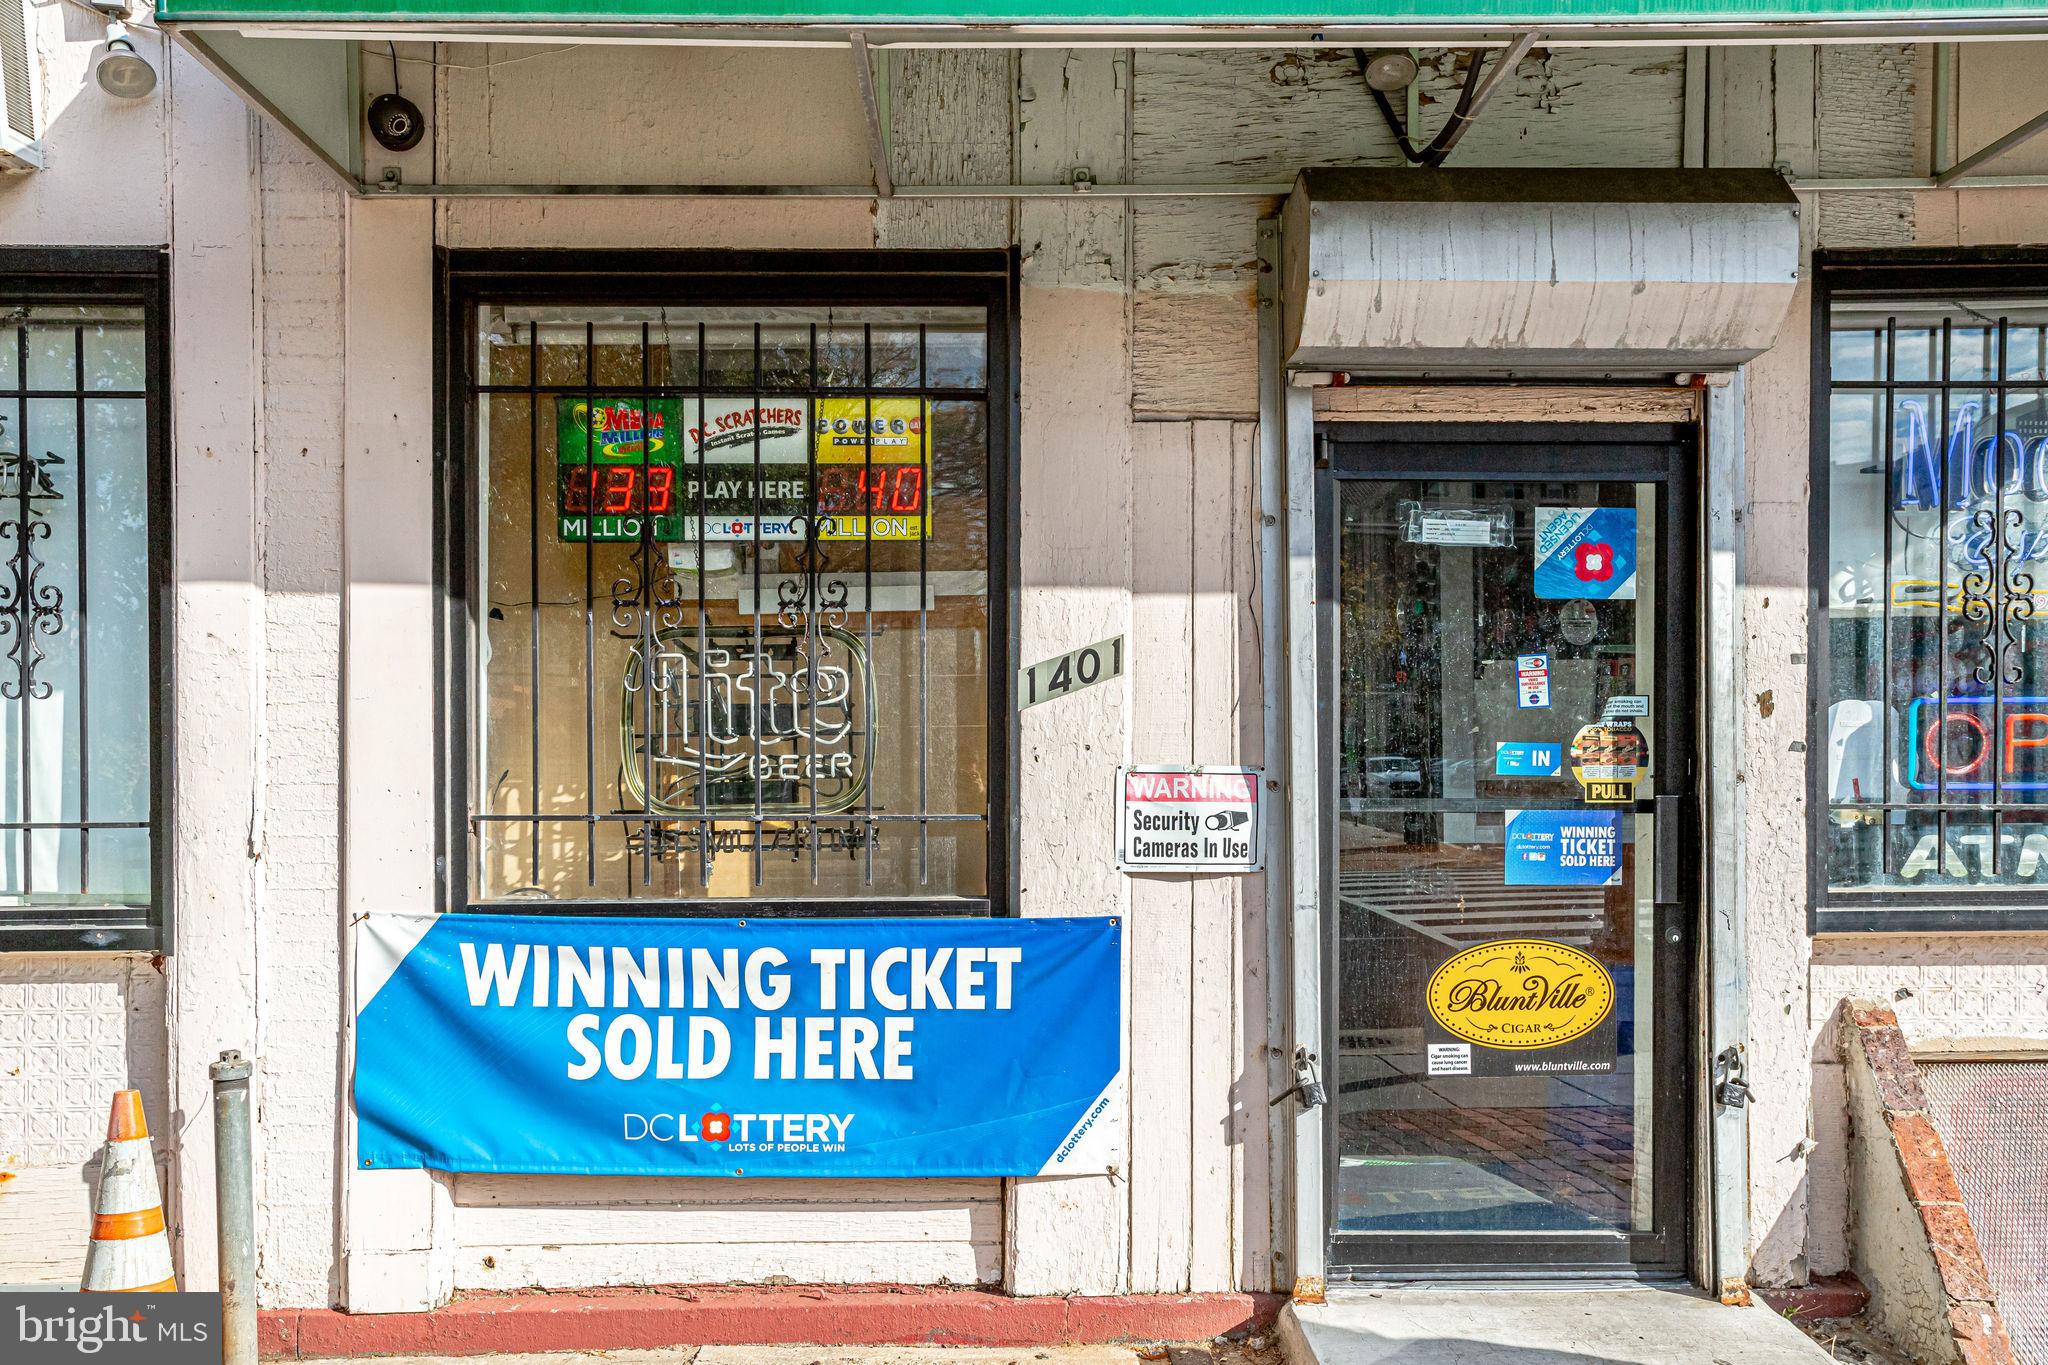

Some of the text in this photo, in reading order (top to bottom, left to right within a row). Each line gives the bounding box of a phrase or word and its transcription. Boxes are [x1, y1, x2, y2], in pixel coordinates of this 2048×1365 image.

[715, 408, 802, 432] SCRATCHERS
[711, 436, 735, 447] Instant
[736, 431, 761, 439] Scrat
[688, 481, 804, 499] PLAY HERE
[857, 466, 923, 512] 40
[817, 517, 908, 537] MILLON
[1538, 511, 1568, 542] AGENT
[1538, 512, 1581, 554] LICENSED
[1026, 638, 1121, 704] 1401
[749, 752, 853, 780] BEER
[1532, 750, 1551, 767] IN
[1133, 777, 1250, 799] WARNING
[1591, 784, 1626, 799] PULL
[1133, 809, 1200, 835] Security
[1560, 826, 1616, 839] WINNING
[1133, 836, 1249, 858] Cameras In Use
[1560, 838, 1616, 855] TICKET
[1560, 855, 1616, 867] SOLD HERE
[460, 943, 1022, 1011] WINNING TICKET
[1501, 1023, 1541, 1034] CIGAR
[567, 1014, 914, 1080] SOLD HERE
[1515, 1061, 1610, 1072] www.bluntville.com
[1056, 1097, 1110, 1163] dclottery.com
[729, 1143, 845, 1153] LOTS OF PEOPLE WIN
